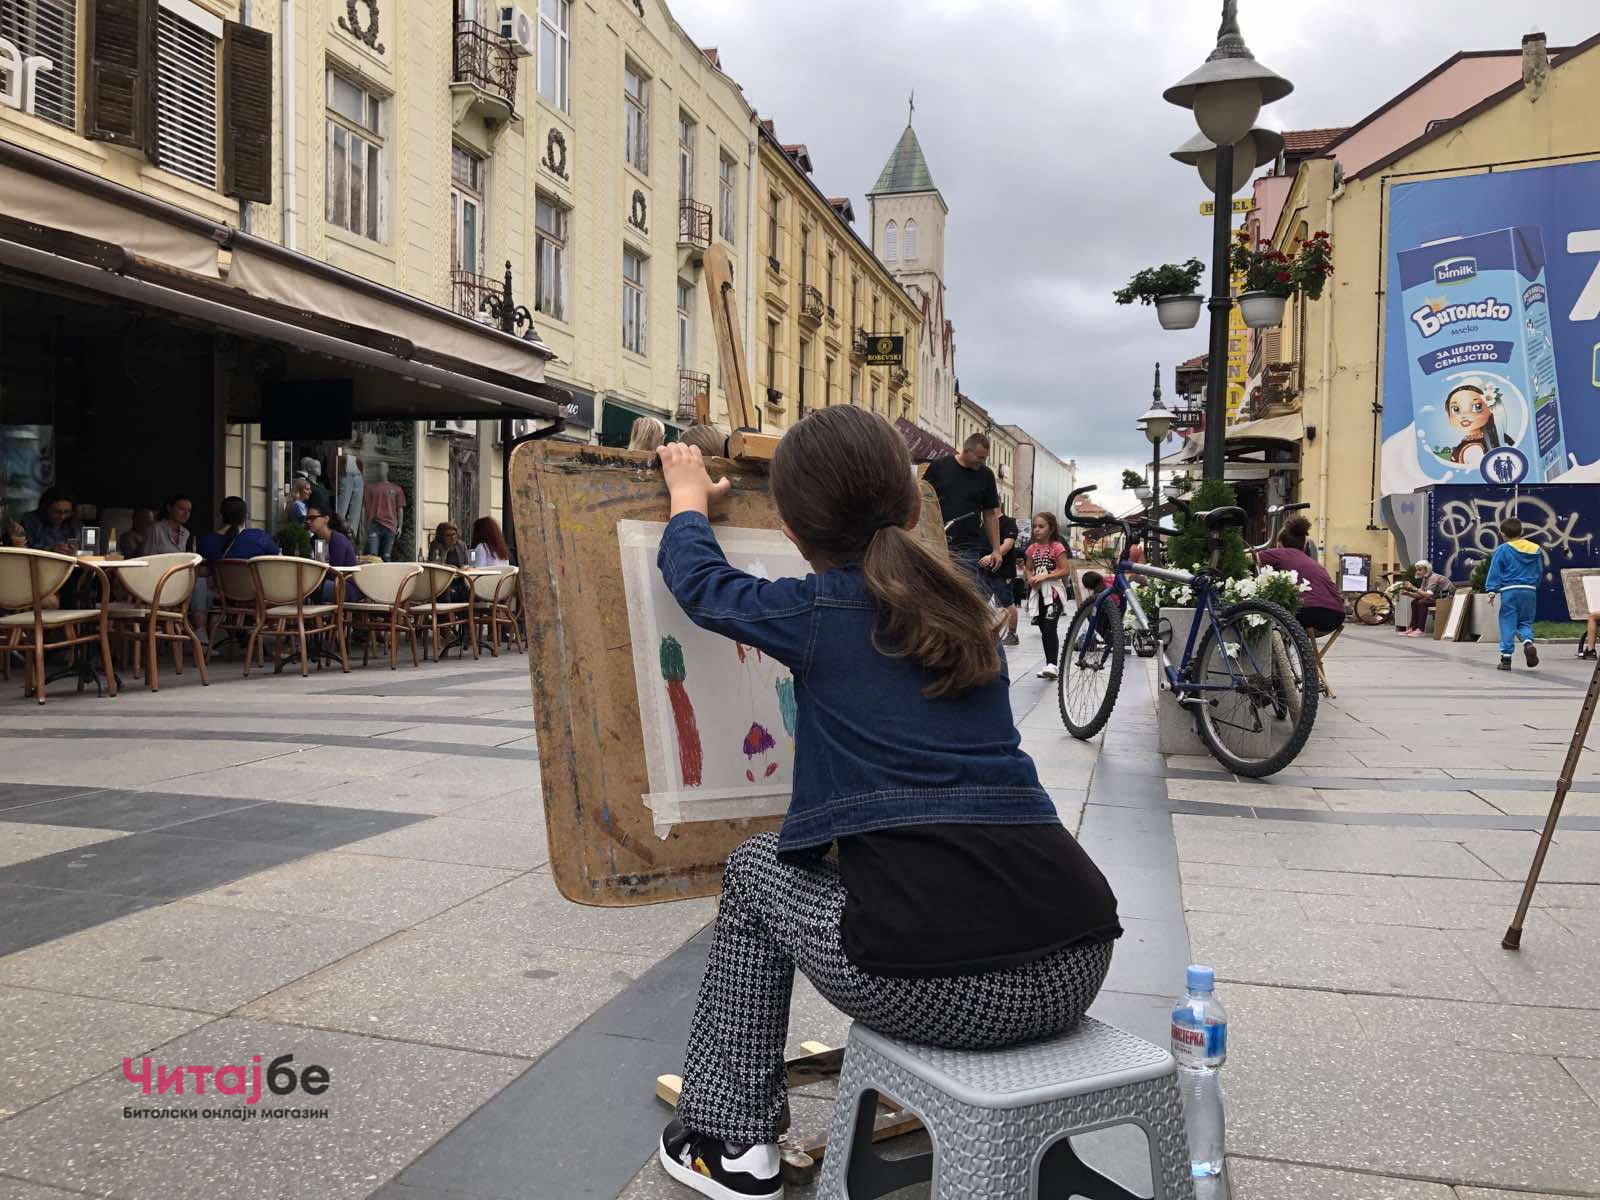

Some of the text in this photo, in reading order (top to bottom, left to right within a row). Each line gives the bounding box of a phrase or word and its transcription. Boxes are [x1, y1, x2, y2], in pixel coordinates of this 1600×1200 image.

[1205, 201, 1249, 212] HEL
[1438, 265, 1473, 280] bimilk
[1411, 298, 1512, 338] Битолско
[1436, 343, 1494, 360] ЗА ЦЕЛОТО
[1435, 353, 1498, 369] СЕМЕЈСТВО
